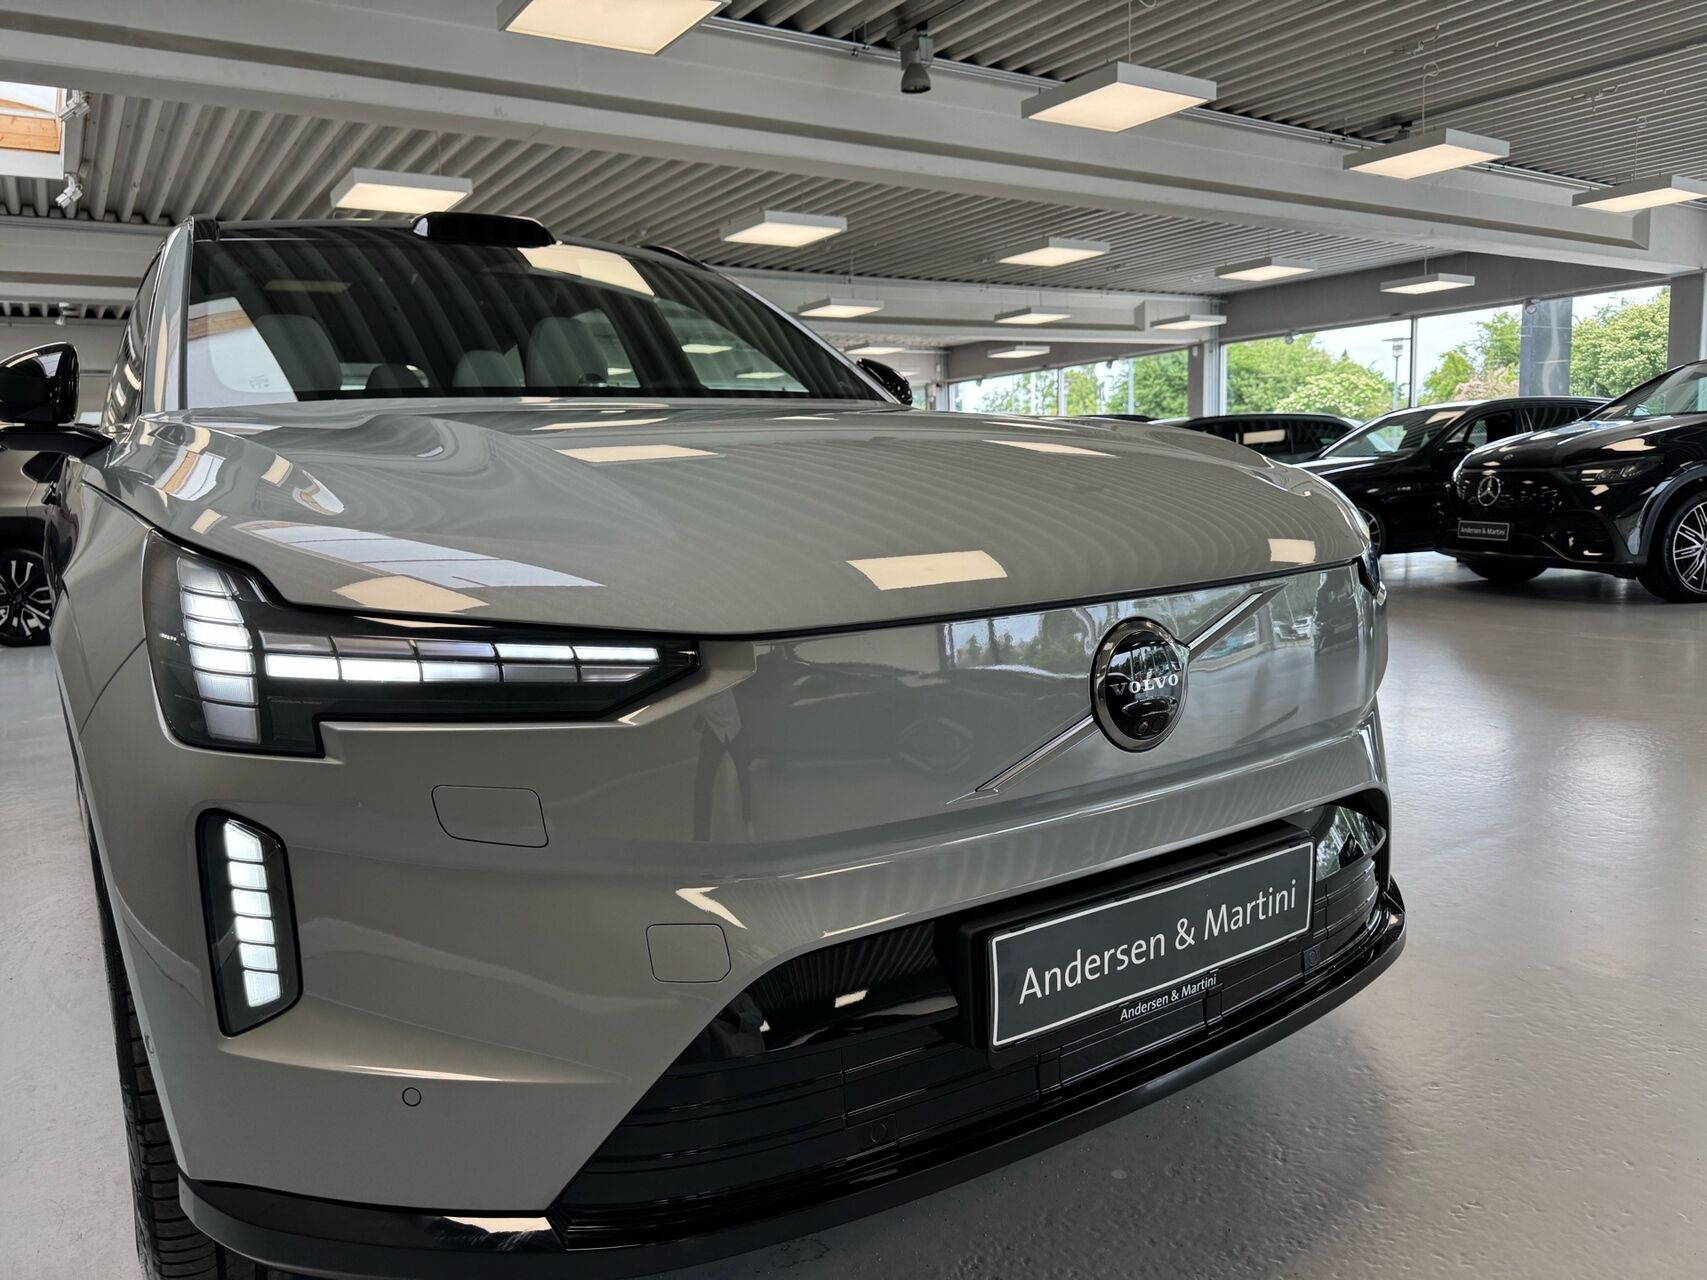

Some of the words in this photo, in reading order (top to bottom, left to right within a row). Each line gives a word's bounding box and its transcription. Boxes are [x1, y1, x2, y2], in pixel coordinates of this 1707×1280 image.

[1109, 673, 1179, 696] VOLVO
[1018, 932, 1166, 1005] Andersen
[1174, 917, 1196, 951] &
[1203, 878, 1297, 941] Martini
[1119, 995, 1169, 1021] Andersen
[1170, 989, 1180, 1002] &
[1181, 973, 1217, 998] Martini
